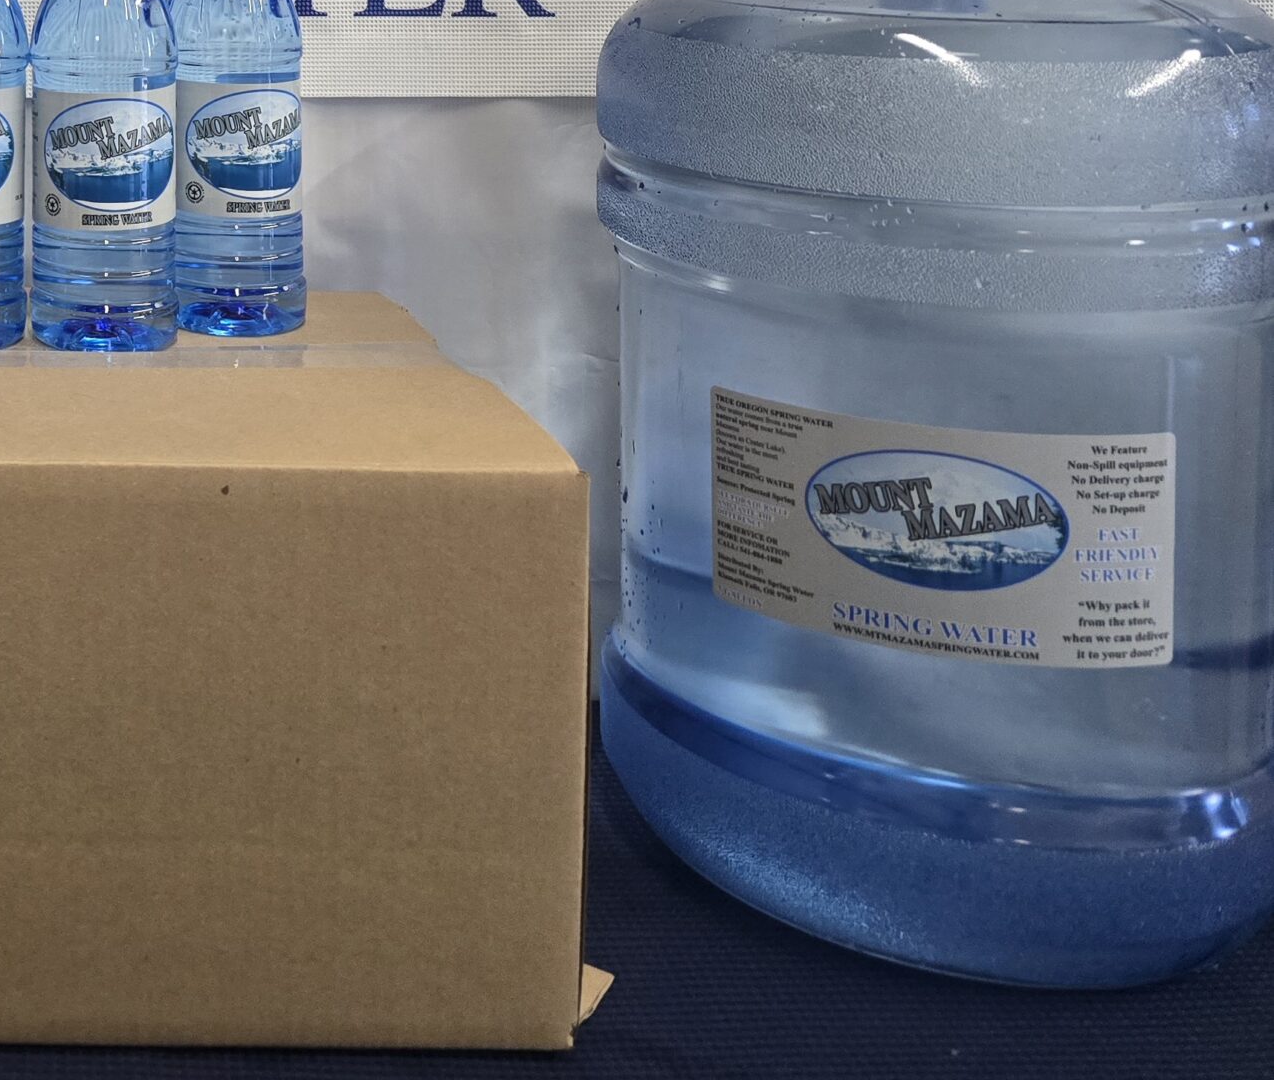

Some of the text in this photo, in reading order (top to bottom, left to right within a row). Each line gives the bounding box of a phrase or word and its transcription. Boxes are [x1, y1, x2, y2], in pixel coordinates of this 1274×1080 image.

[193, 106, 262, 140] MOUNT
[243, 108, 300, 150] MAZAM
[49, 116, 114, 151] MOUNT
[96, 114, 173, 161] MAZAMA
[226, 198, 291, 214] SPRING WATER
[81, 211, 153, 226] SPRING WATER
[716, 394, 833, 427] TRUE OREGON SPRING WATER
[1091, 445, 1148, 454] We Feature
[1067, 459, 1167, 471] Non-Spill equipment
[717, 462, 735, 473] TRUE
[737, 469, 764, 481] SPRING
[767, 477, 794, 489] WATER
[1071, 474, 1164, 486] No Delivery charge
[814, 477, 932, 515] MOUNT
[1076, 490, 1160, 500] No Set-up charge
[901, 493, 1056, 541] MAZAMA
[1092, 505, 1146, 515] No Deposit
[718, 520, 778, 544] FOR SERVICE OR
[718, 528, 737, 541] MORE
[1099, 528, 1139, 540] FAST
[1076, 547, 1157, 561] FRIENDLY
[1080, 568, 1154, 581] SERVICE
[1114, 600, 1140, 612] pack
[1142, 599, 1150, 607] it
[832, 601, 1038, 648] SPRING WATER
[1078, 617, 1105, 626] from
[1108, 617, 1125, 626] the
[832, 622, 1039, 661] WWW.MTMAZAMASPRINGWATER.COM
[1062, 633, 1093, 643] when
[1134, 632, 1168, 641] deliver
[1076, 649, 1085, 658] it
[1088, 650, 1099, 658] to
[1102, 650, 1128, 660] your
